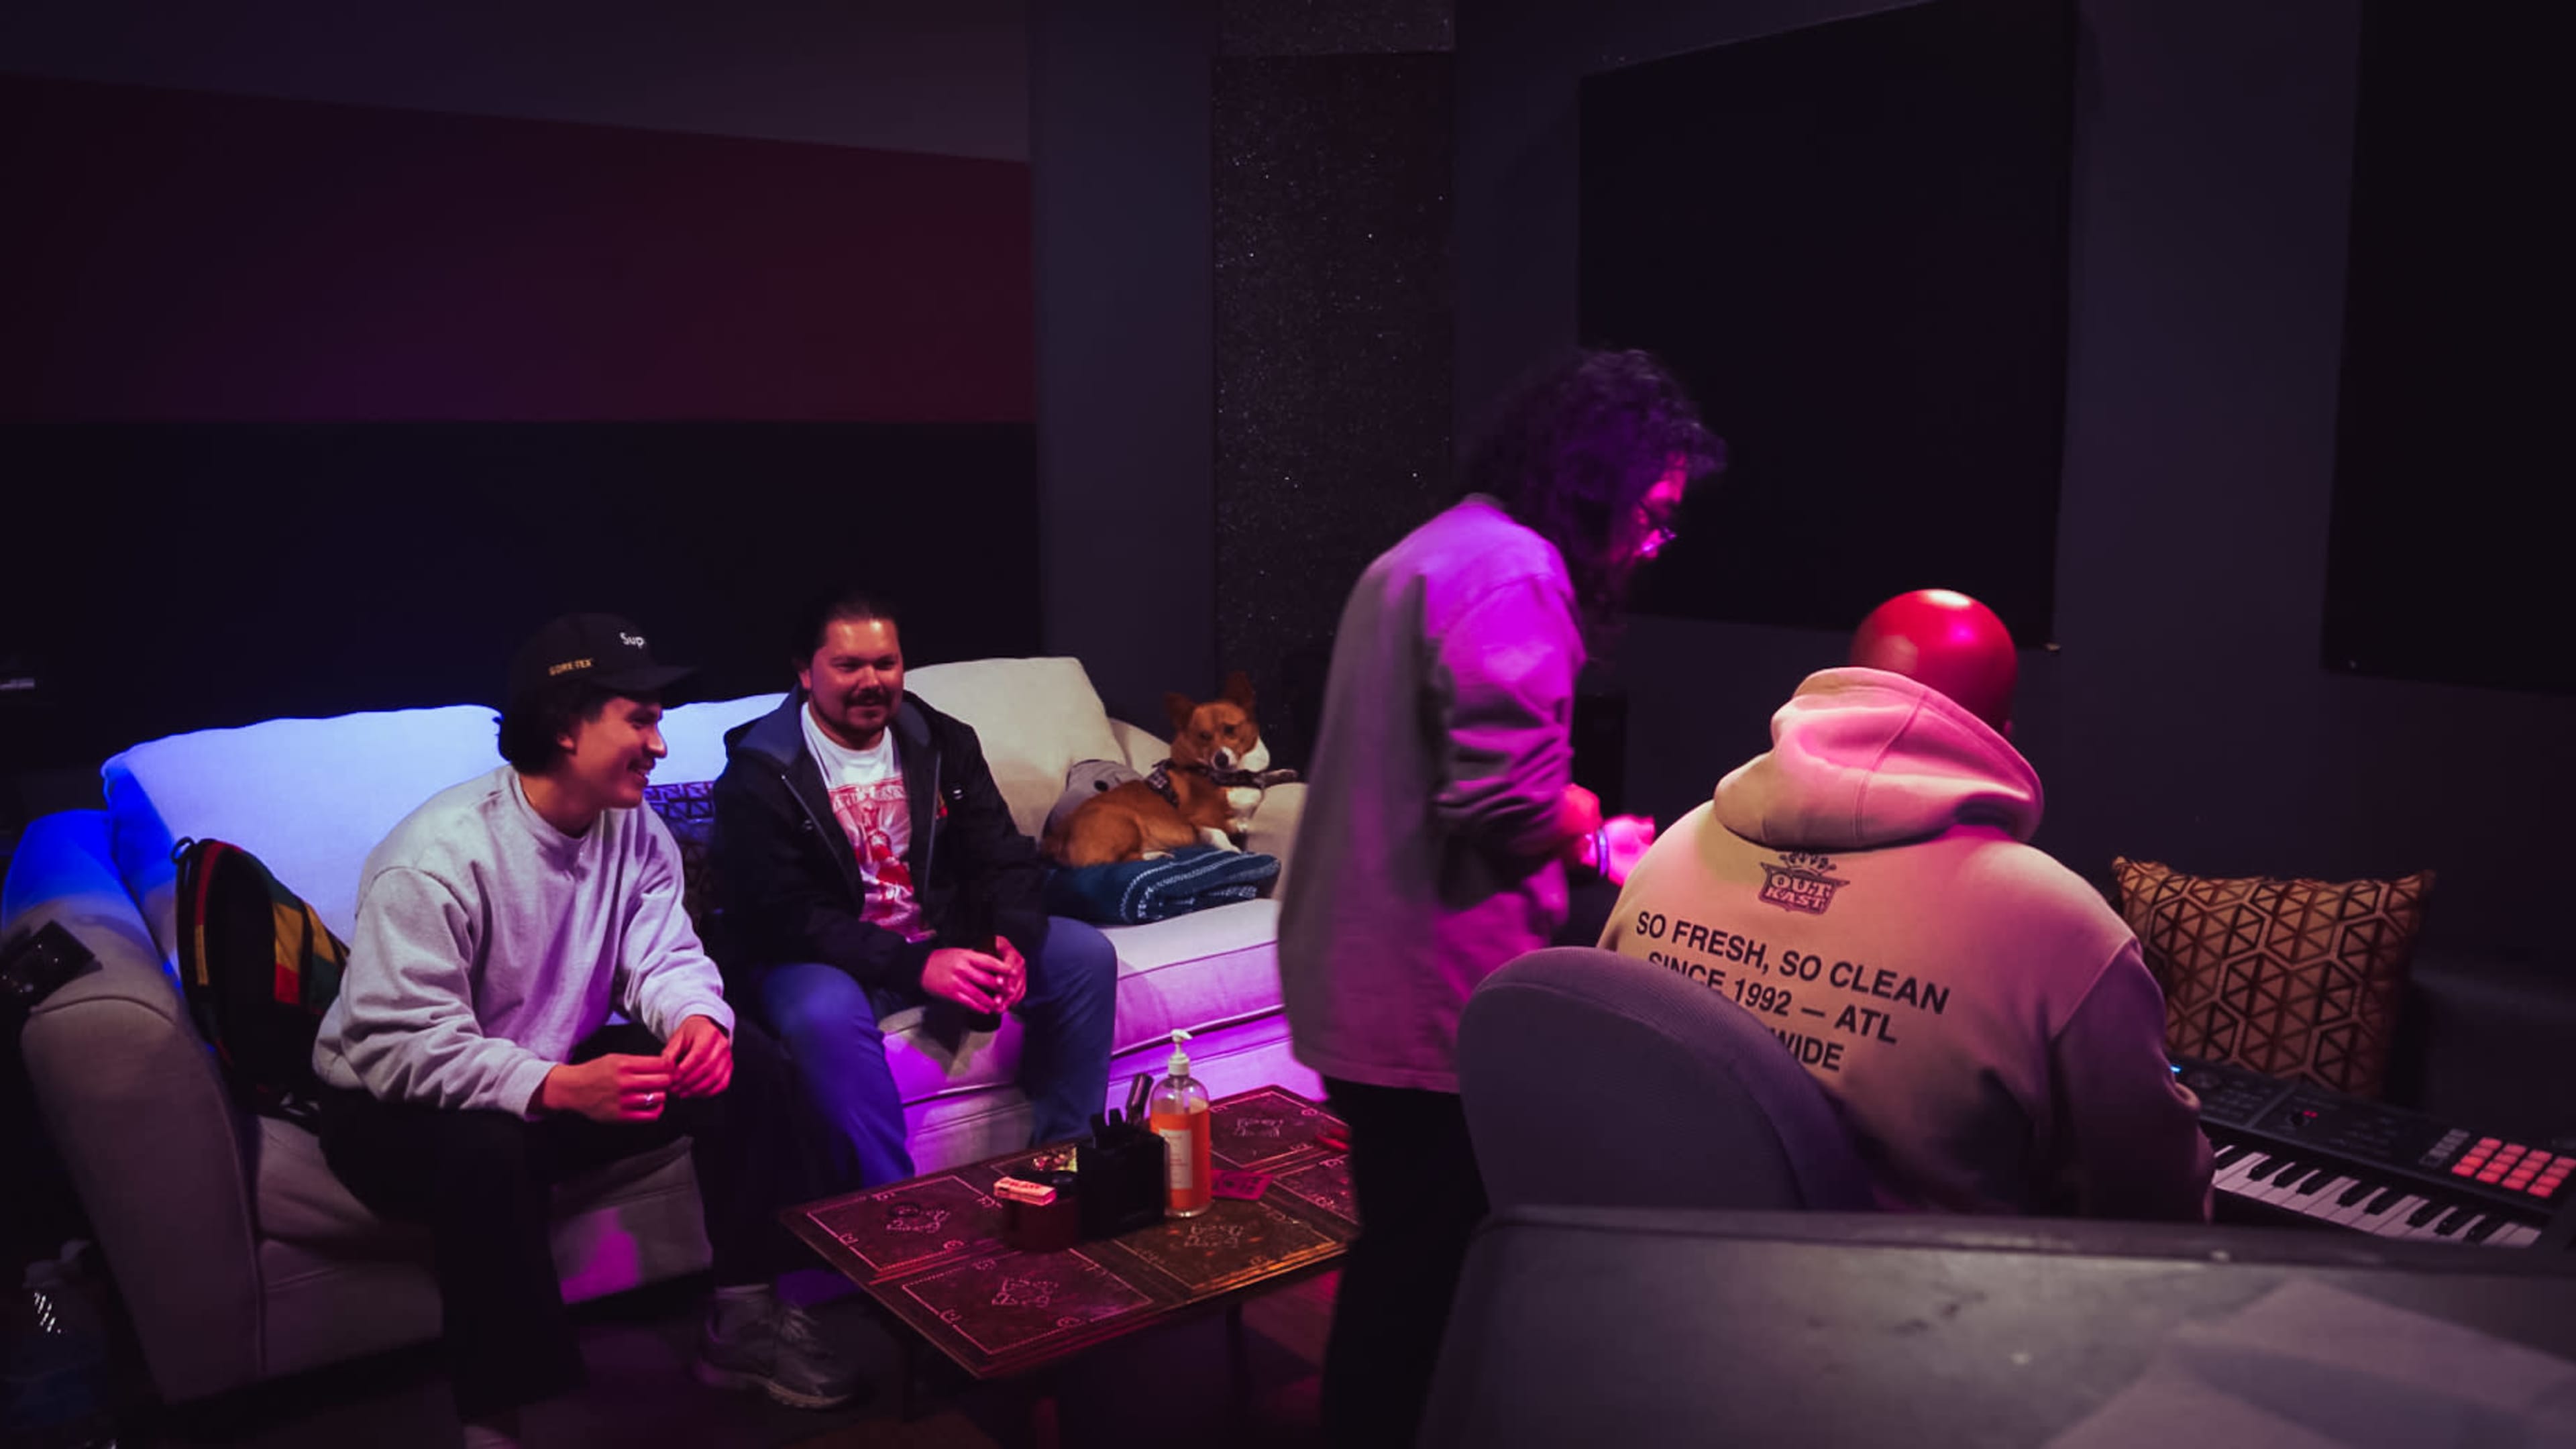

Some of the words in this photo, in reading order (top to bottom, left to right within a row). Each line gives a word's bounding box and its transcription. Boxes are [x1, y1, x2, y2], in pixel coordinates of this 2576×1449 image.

[1765, 886, 1826, 909] KAST
[1770, 873, 1832, 898] OUT
[1636, 911, 1666, 939] SO
[1671, 919, 1770, 976] FRESH,
[1779, 950, 1823, 981] SO
[1829, 961, 1950, 1015] CLEAN
[1734, 977, 1792, 1016] 1992
[1834, 1004, 1898, 1045] ATL
